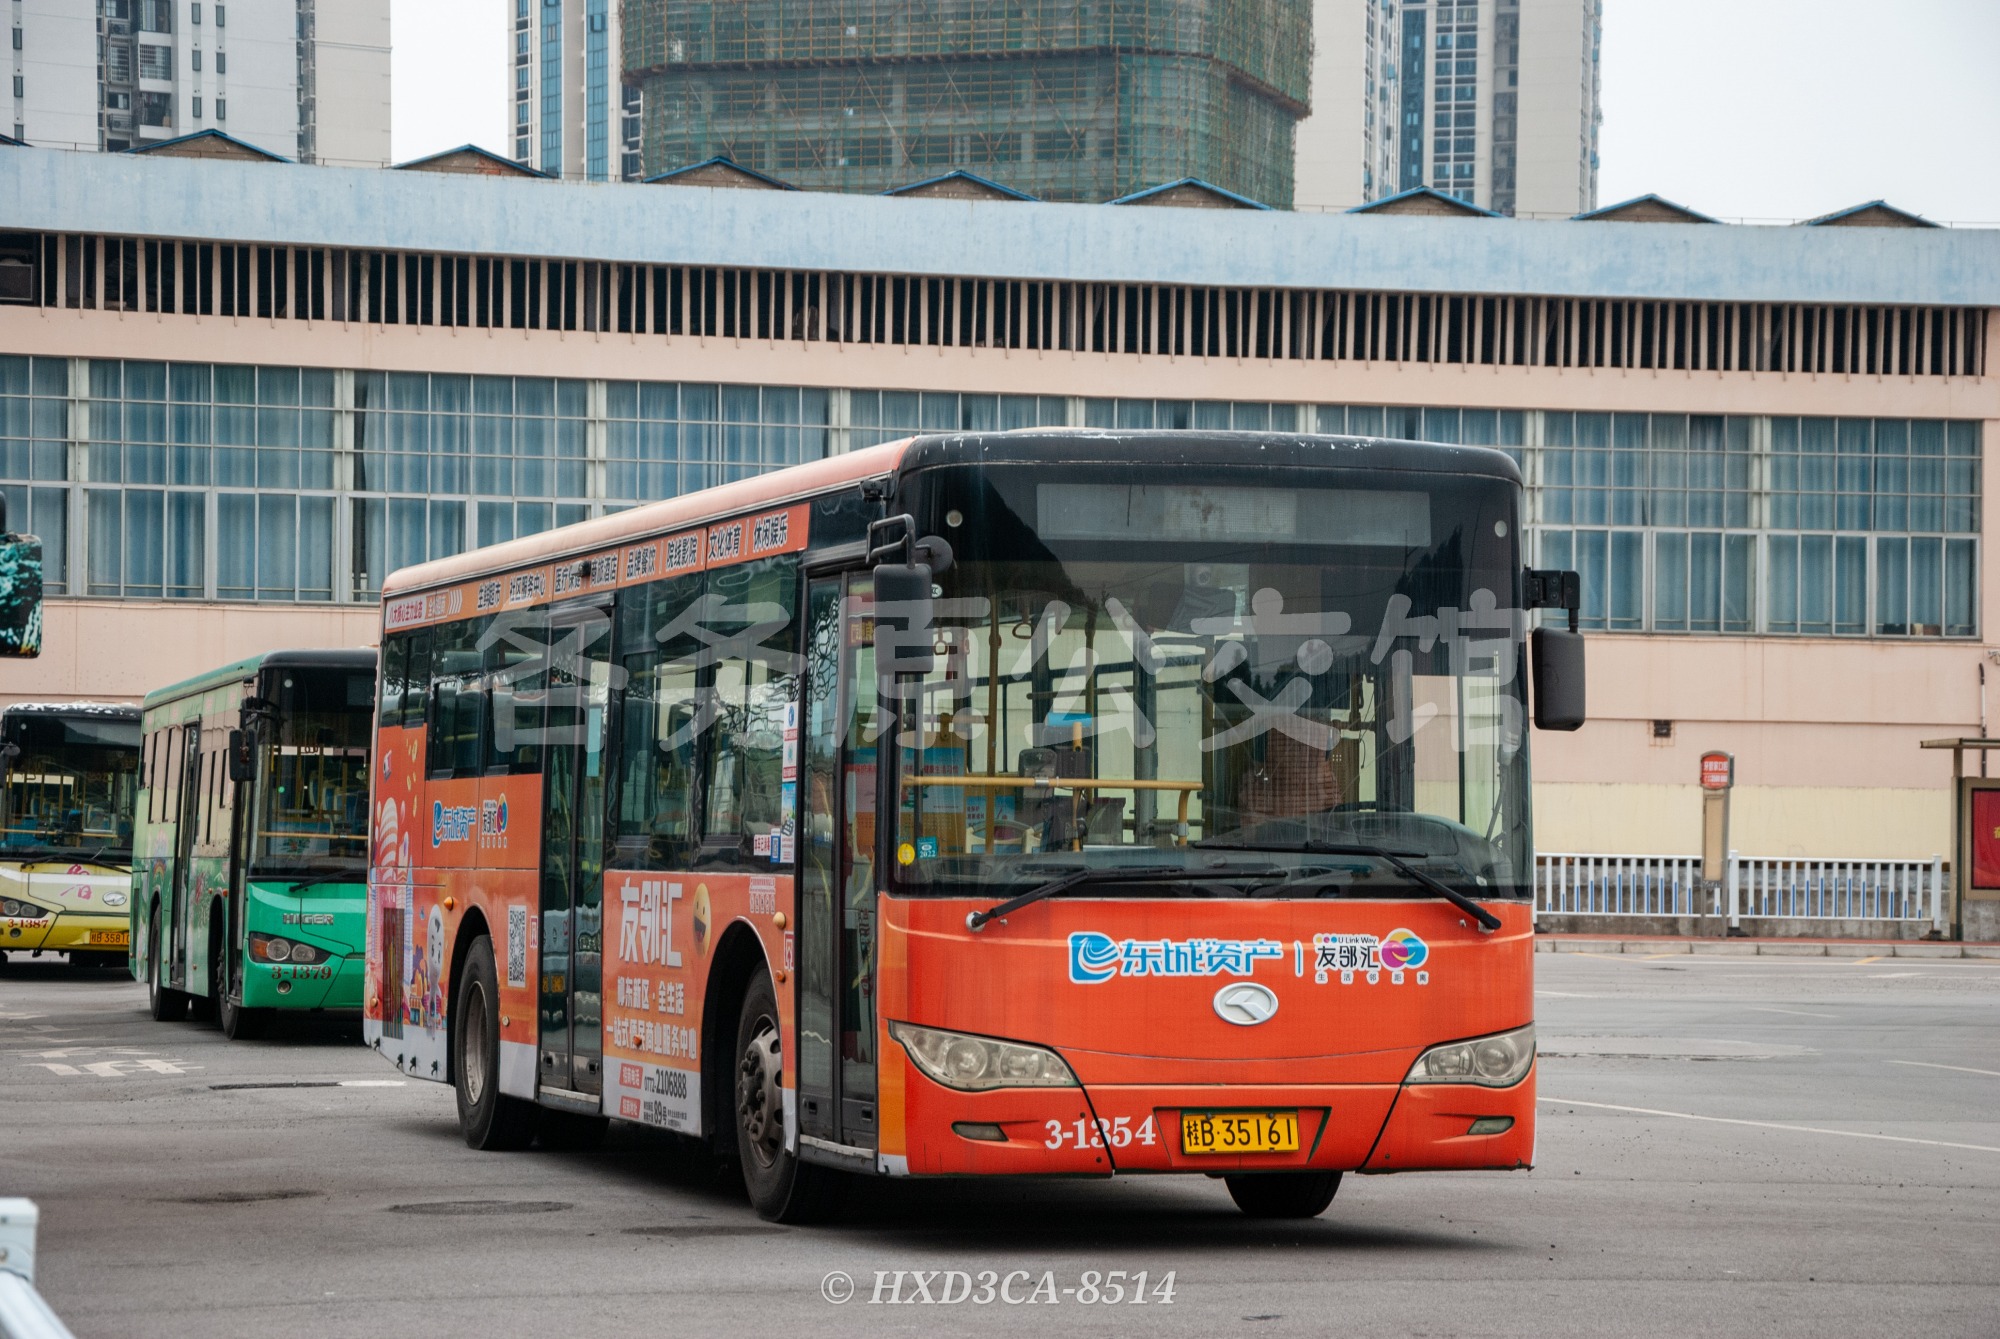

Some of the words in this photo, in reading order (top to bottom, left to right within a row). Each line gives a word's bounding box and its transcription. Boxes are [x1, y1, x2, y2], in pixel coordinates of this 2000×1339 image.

[708, 523, 742, 562] 文化体育
[753, 512, 788, 553] 休闲娱乐
[509, 571, 546, 602] 社区服务中心
[443, 806, 477, 840] 东城资产
[8, 918, 49, 929] 3-1387
[283, 913, 334, 925] HIGER
[619, 876, 683, 968] 友邻汇
[1121, 940, 1283, 974] 东城资产
[1317, 945, 1379, 968] 友邻汇
[1360, 937, 1377, 945] Way
[271, 965, 332, 979] 3-1379
[1044, 1115, 1157, 1149] 3-1354
